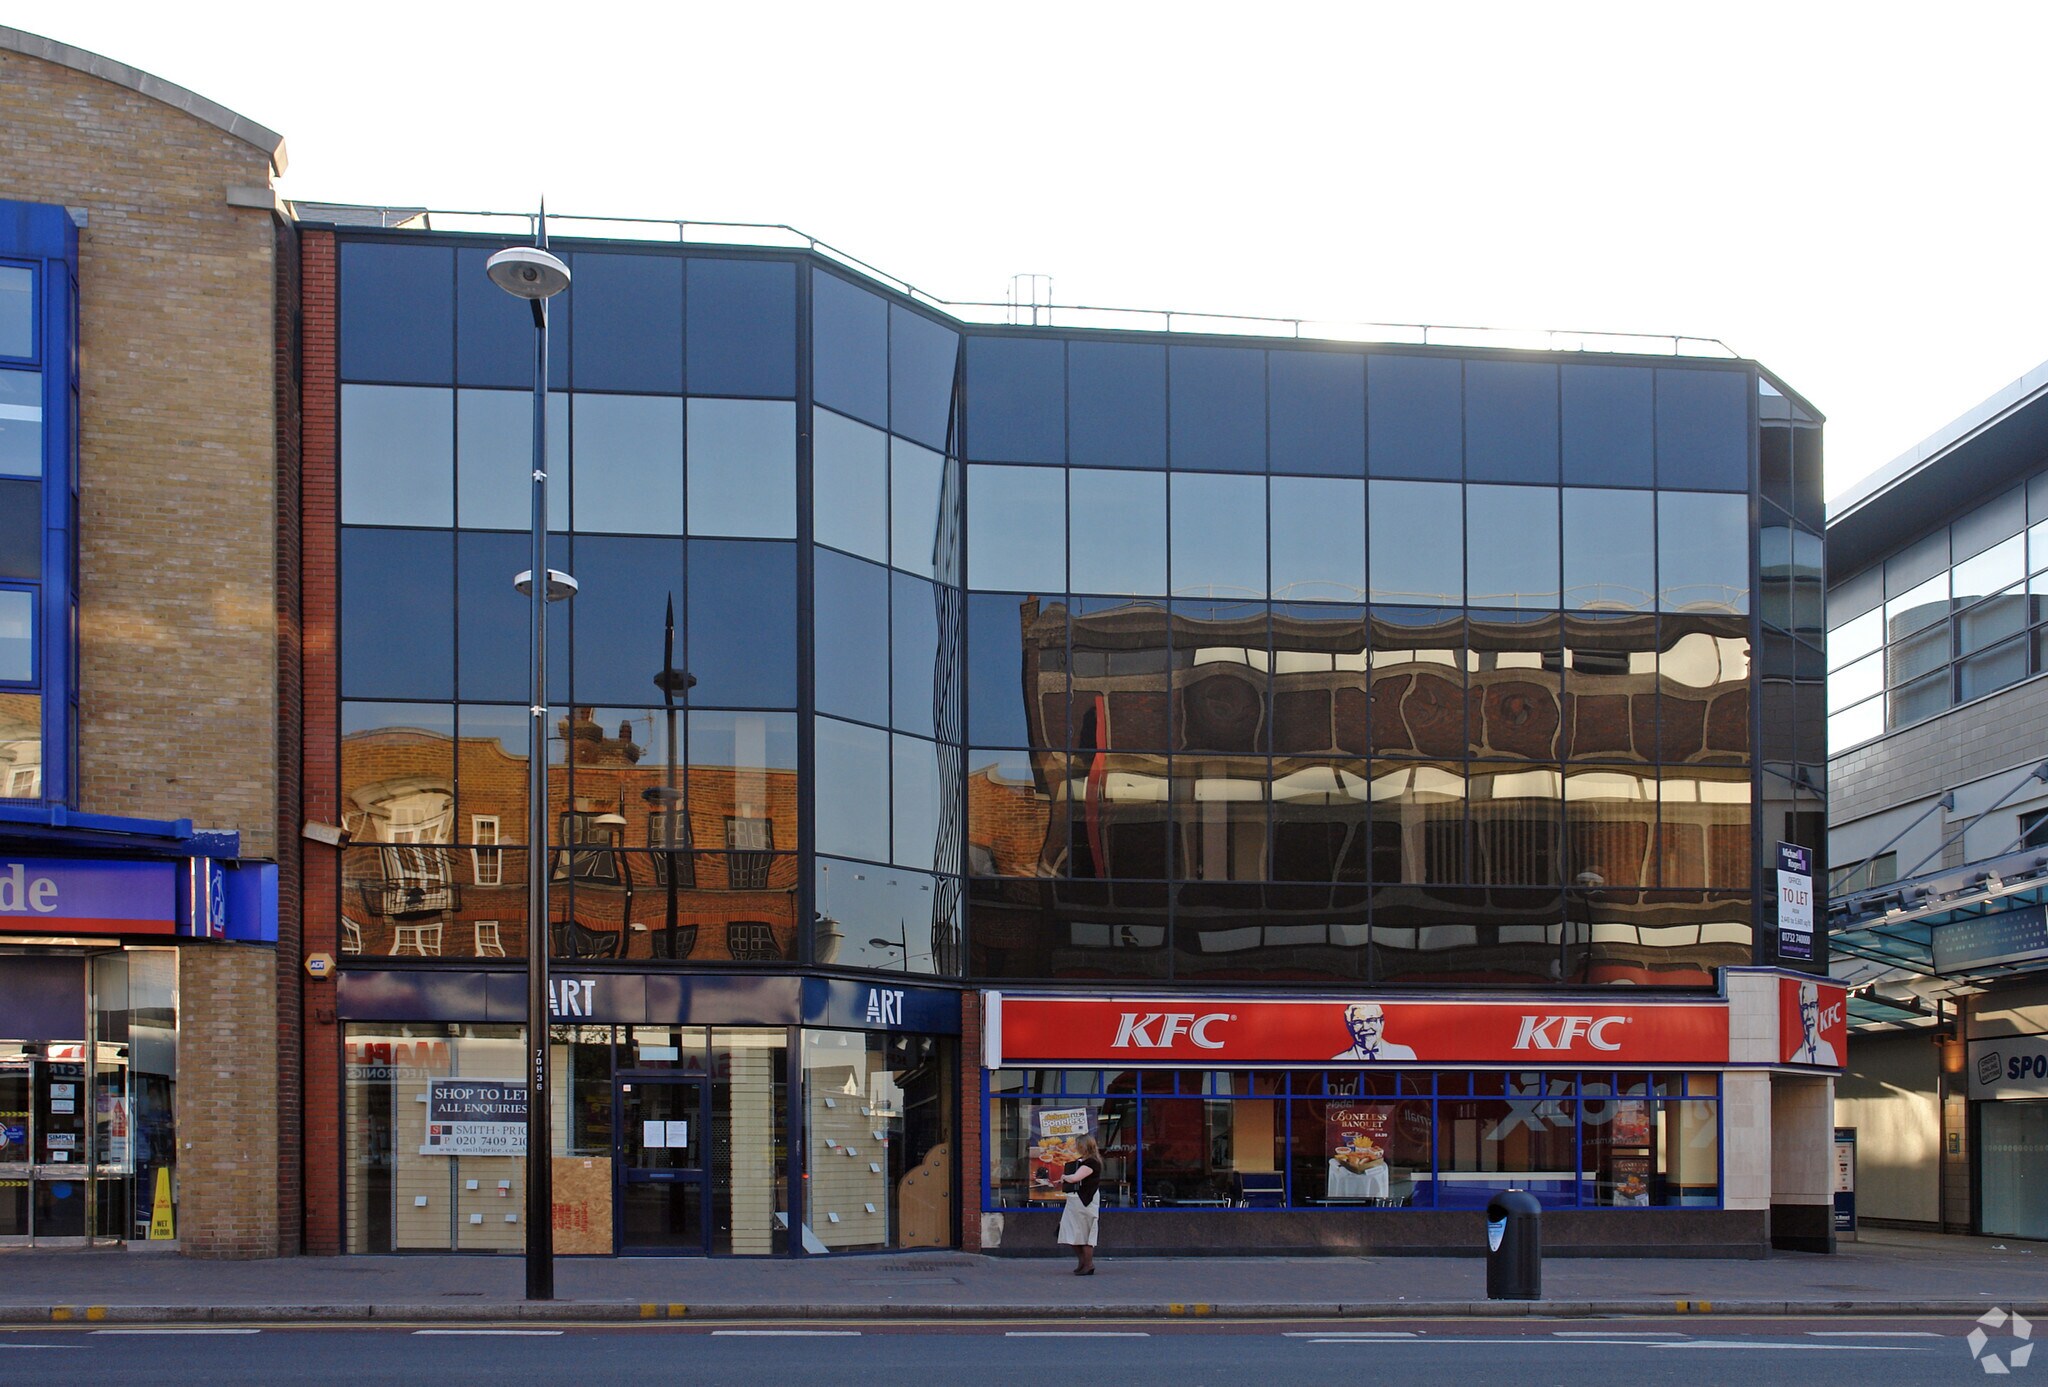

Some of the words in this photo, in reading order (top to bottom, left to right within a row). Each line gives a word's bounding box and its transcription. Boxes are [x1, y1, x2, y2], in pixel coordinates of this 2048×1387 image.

[1783, 888, 1794, 903] TO
[1796, 890, 1808, 906] LET
[866, 988, 904, 1025] ART
[1819, 1001, 1842, 1033] KFC
[1110, 1012, 1230, 1049] KFC
[1511, 1015, 1626, 1051] KFC
[2007, 1054, 2048, 1080] SPO
[435, 1088, 474, 1100] SHOP
[477, 1088, 500, 1100] TO
[438, 1103, 461, 1113] ALL
[464, 1103, 527, 1115] ENQUIRIES
[1331, 1110, 1387, 1122] BONELESS
[1042, 1118, 1085, 1127] boneless
[1341, 1121, 1383, 1129] BANQUET
[456, 1125, 495, 1135] SMITH
[456, 1136, 476, 1146] 020
[481, 1136, 507, 1146] 7409
[154, 1228, 170, 1236] FLOOR
